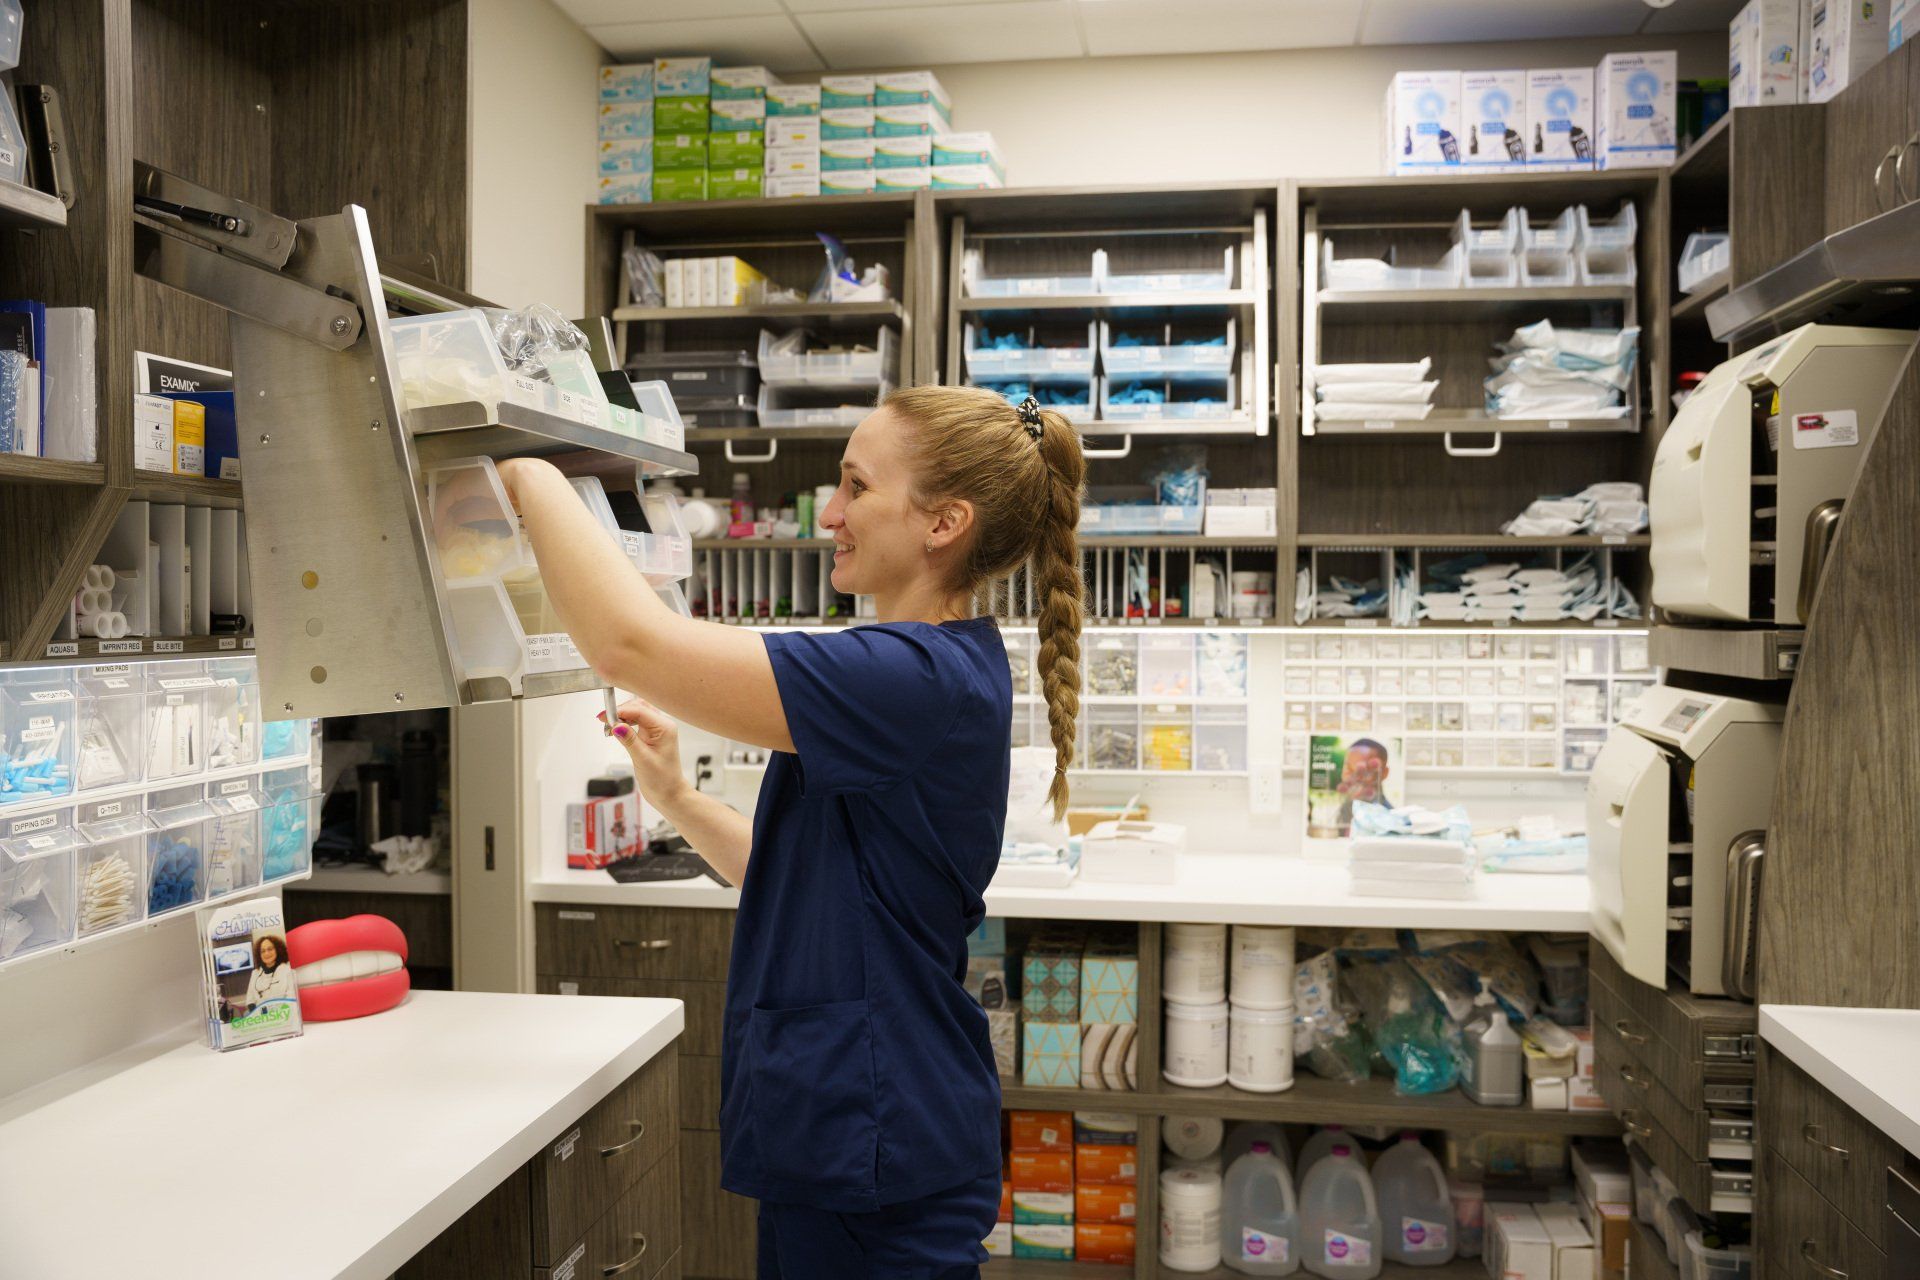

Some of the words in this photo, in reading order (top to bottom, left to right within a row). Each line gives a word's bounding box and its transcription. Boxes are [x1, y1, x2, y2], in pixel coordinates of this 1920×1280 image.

[128, 642, 140, 650] REG
[156, 642, 170, 650] BLUE
[170, 642, 182, 650] BITE
[14, 820, 40, 832] DIPPING
[40, 817, 54, 827] DISH
[215, 914, 281, 936] HAPPINESS
